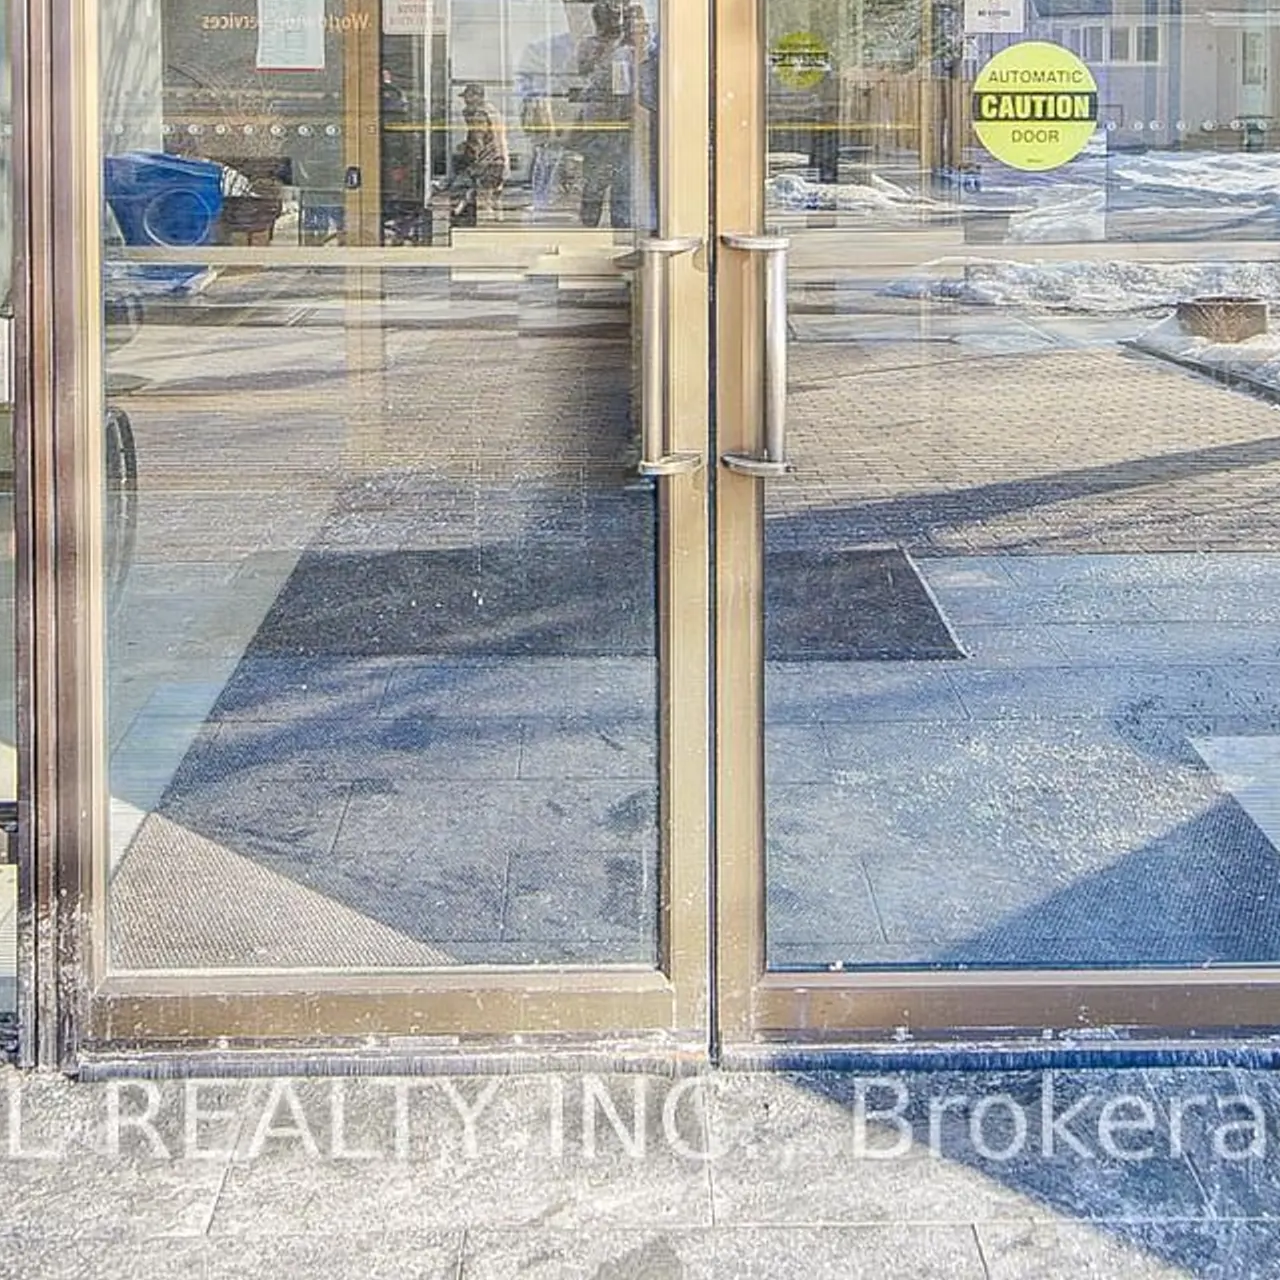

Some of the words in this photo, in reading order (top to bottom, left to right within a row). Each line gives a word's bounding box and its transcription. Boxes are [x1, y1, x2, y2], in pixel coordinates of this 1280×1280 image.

[988, 69, 1083, 83] AUTOMATIC
[980, 94, 1090, 119] CAUTION
[1011, 129, 1060, 143] DOOR
